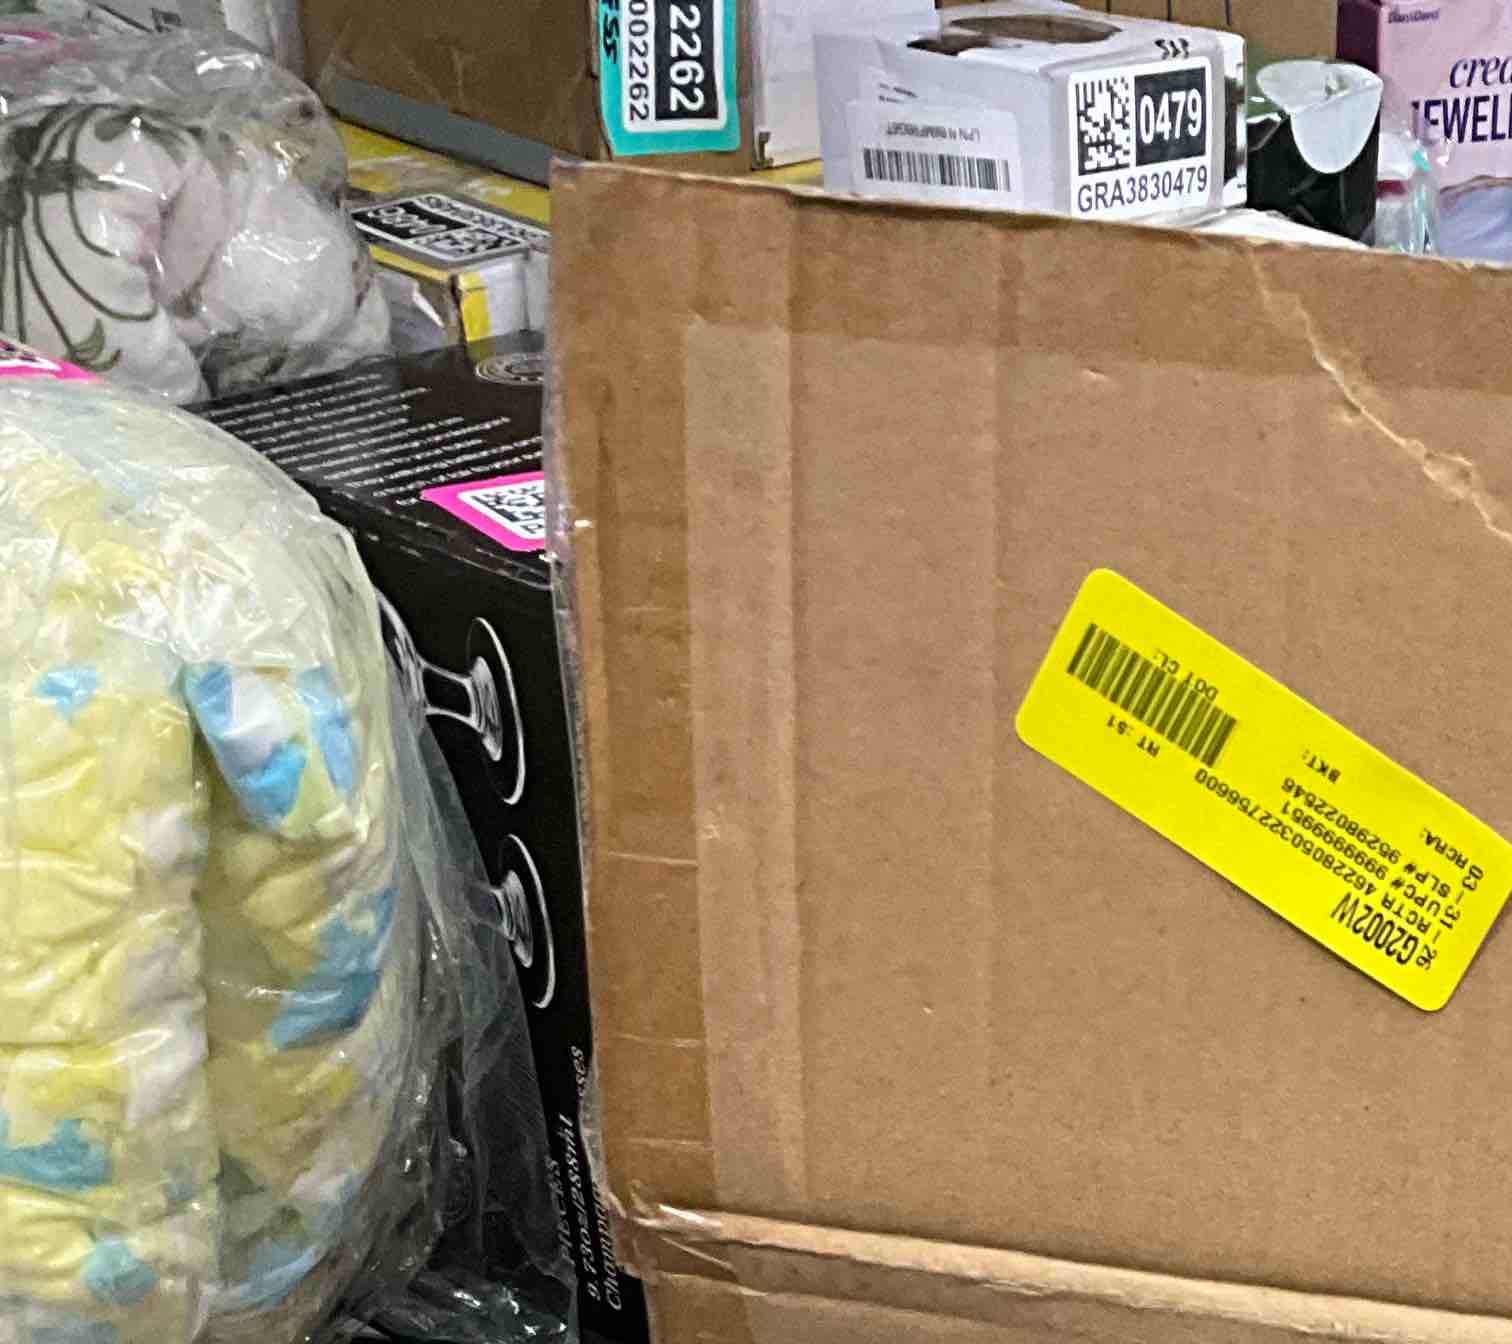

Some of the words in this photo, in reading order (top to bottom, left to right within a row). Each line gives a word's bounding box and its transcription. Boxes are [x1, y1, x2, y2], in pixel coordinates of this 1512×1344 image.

[670, 4, 705, 112] 2262
[1138, 87, 1203, 145] 0479
[1077, 165, 1208, 214] GRA3830479
[1419, 827, 1471, 870] RCRA:
[1380, 892, 1431, 935] RCTR
[1390, 879, 1442, 917] UPC#
[1330, 891, 1420, 966] G2002W
